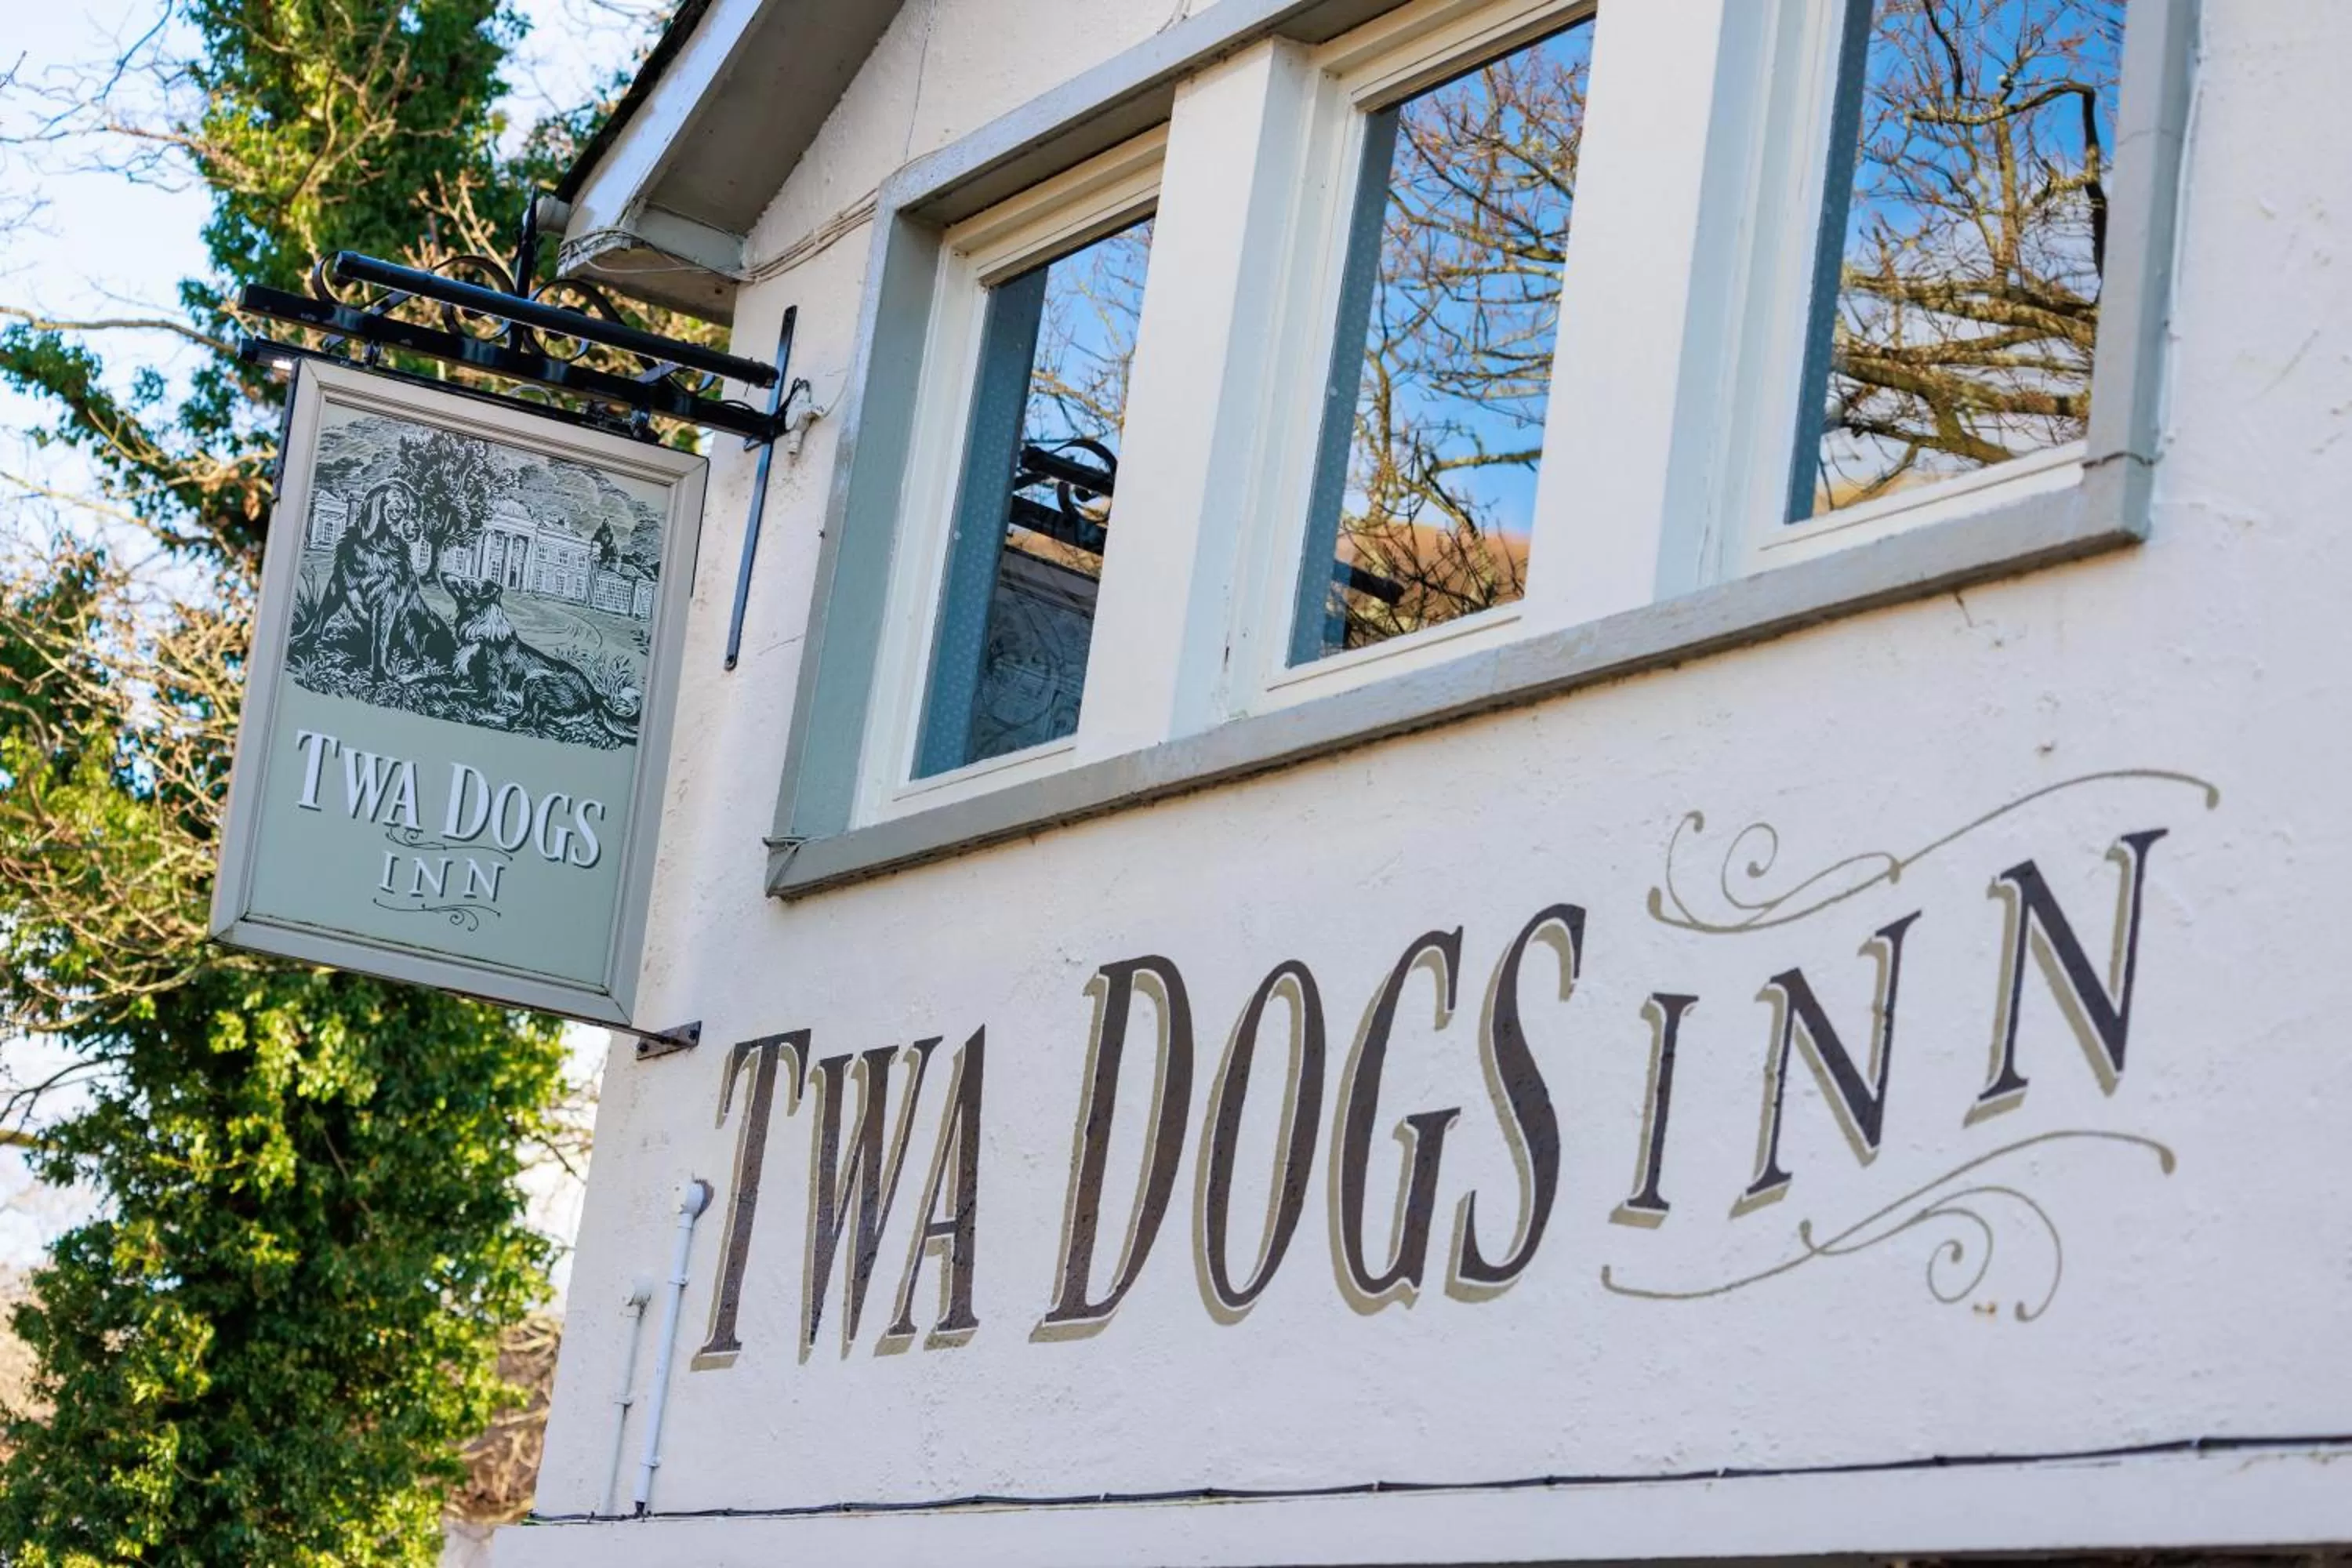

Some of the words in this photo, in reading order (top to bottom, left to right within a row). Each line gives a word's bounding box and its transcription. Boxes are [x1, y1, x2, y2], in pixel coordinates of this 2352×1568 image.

[296, 729, 423, 832] TWA
[441, 761, 605, 869] DOGS
[378, 851, 505, 902] INN
[690, 1023, 986, 1372] TWA
[1028, 902, 1588, 1345] DOGS
[1608, 827, 2169, 1230] INN
